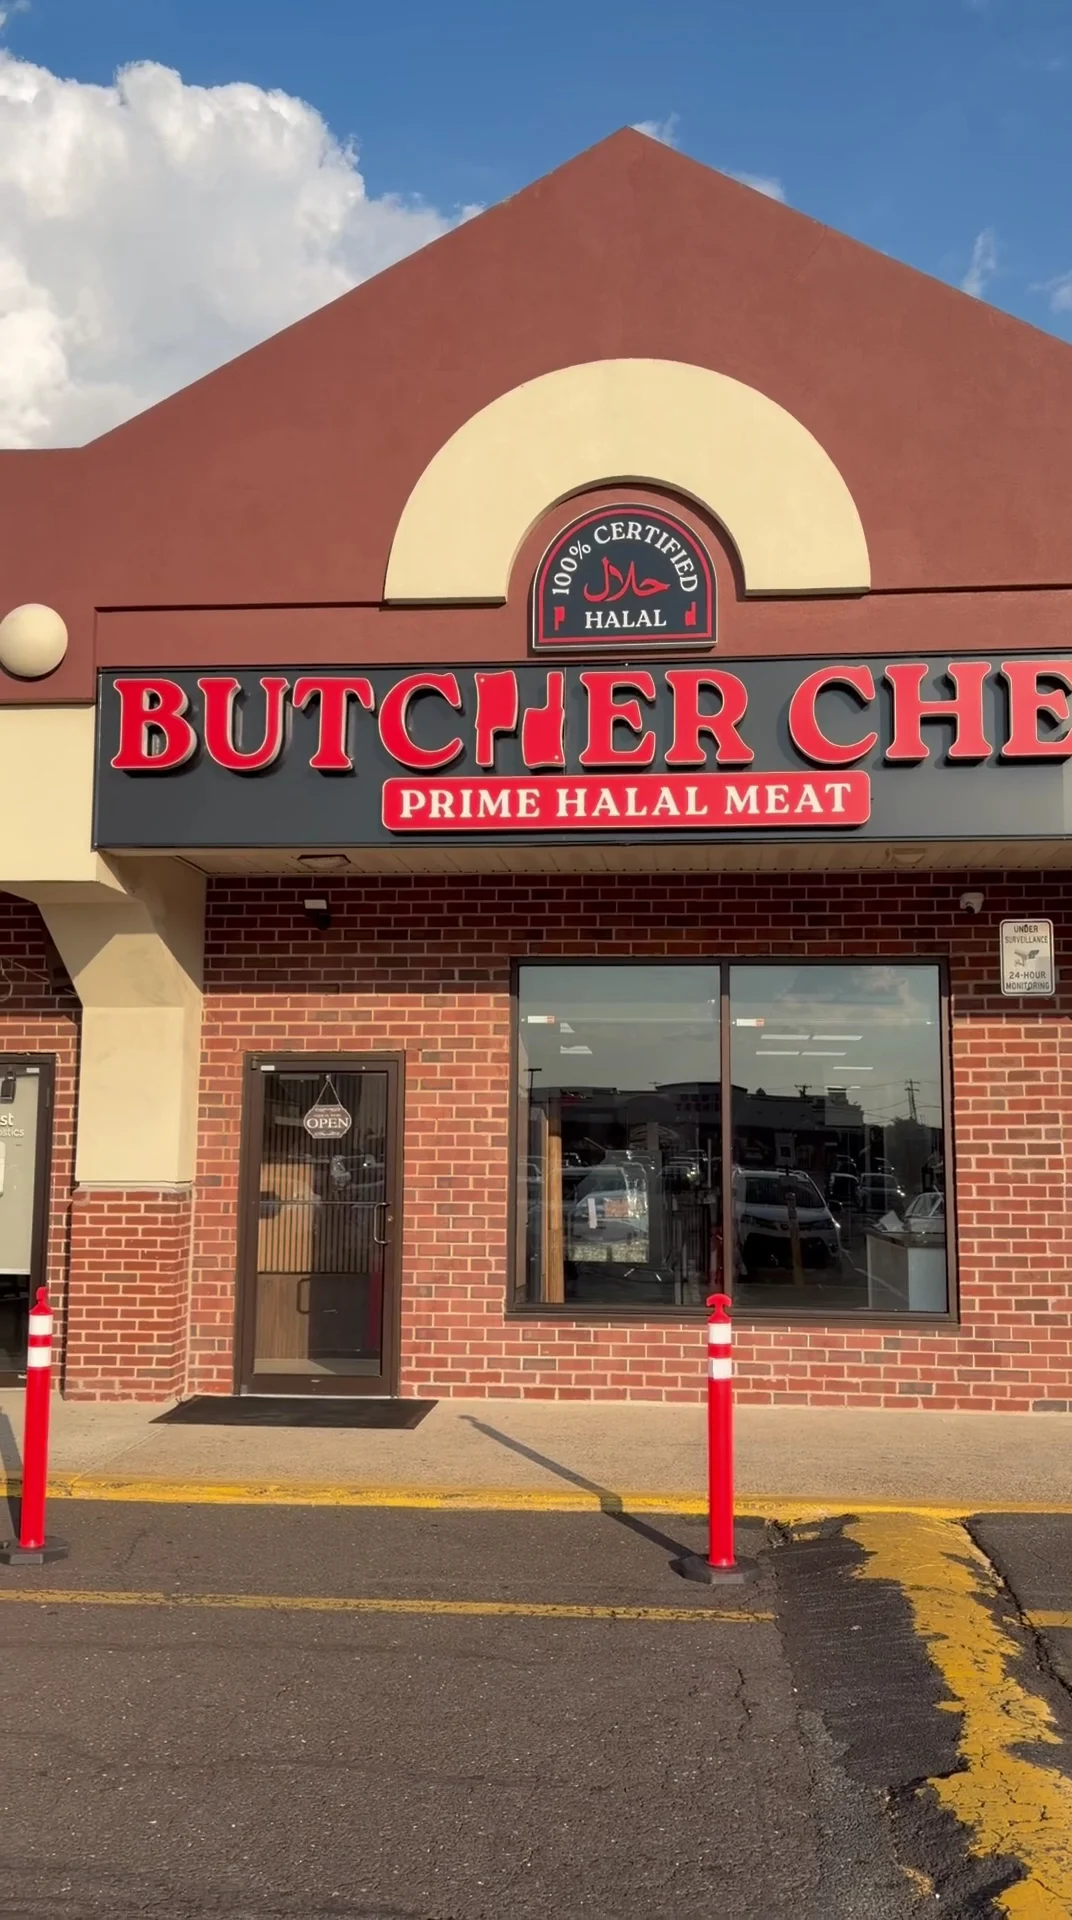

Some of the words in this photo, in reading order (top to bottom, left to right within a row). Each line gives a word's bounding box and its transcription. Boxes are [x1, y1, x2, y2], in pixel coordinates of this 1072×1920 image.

[552, 540, 592, 596] 100%
[593, 521, 698, 593] CERTIFIED
[583, 556, 671, 603] حلال
[585, 609, 667, 629] HALAL
[789, 661, 1072, 766] CHE
[400, 788, 541, 819] PRIME
[556, 786, 708, 817] HALAL
[725, 783, 851, 814] MEAT
[1013, 924, 1039, 933] UNDER
[1009, 971, 1047, 980] 24-HOUR
[1005, 982, 1050, 991] MONITORING
[306, 1117, 348, 1128] OPEN
